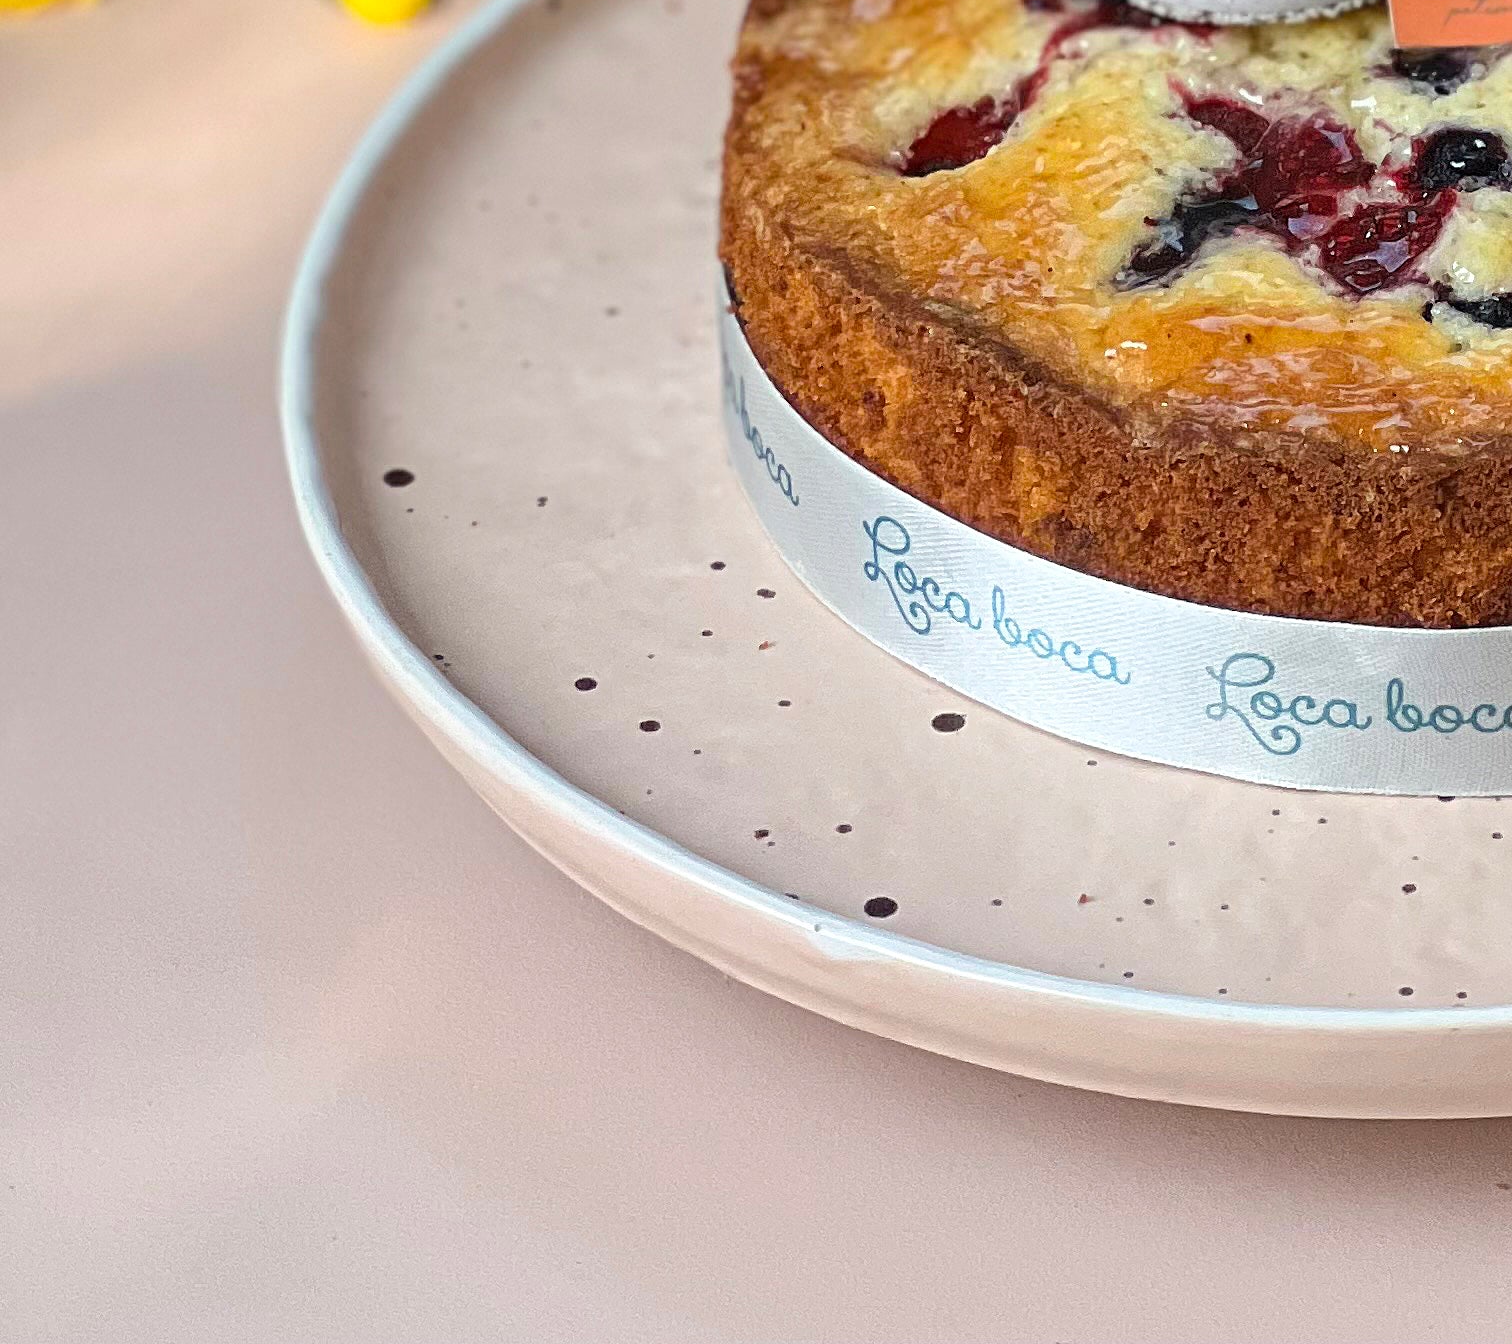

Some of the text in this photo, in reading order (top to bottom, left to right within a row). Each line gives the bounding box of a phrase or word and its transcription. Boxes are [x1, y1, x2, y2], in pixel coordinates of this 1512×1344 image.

[862, 516, 1131, 686] Loca boca
[1205, 652, 1372, 756] Loca
